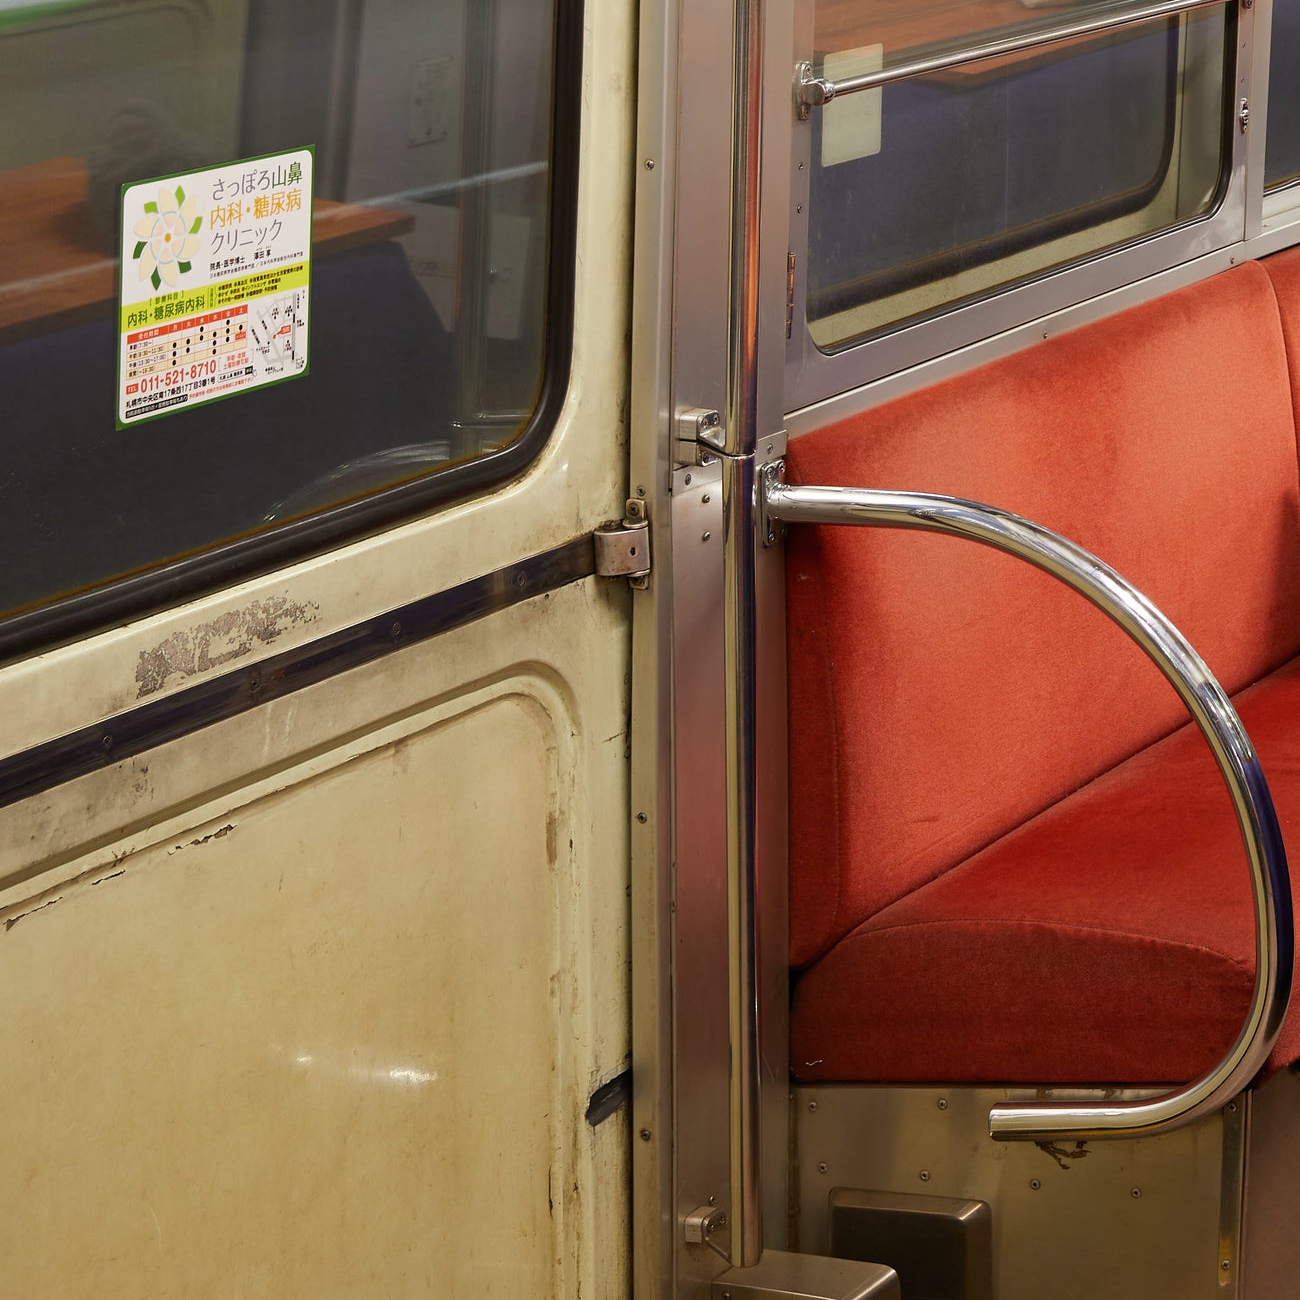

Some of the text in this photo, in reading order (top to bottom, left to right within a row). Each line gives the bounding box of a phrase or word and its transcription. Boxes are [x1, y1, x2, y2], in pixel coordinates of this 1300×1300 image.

[212, 161, 303, 201] さっぽろ山鼻
[210, 189, 302, 230] 内科・糖尿病
[210, 218, 283, 255] クリニック
[128, 295, 205, 328] 内科・糖尿病内科
[141, 359, 217, 393] 011-521-8710
